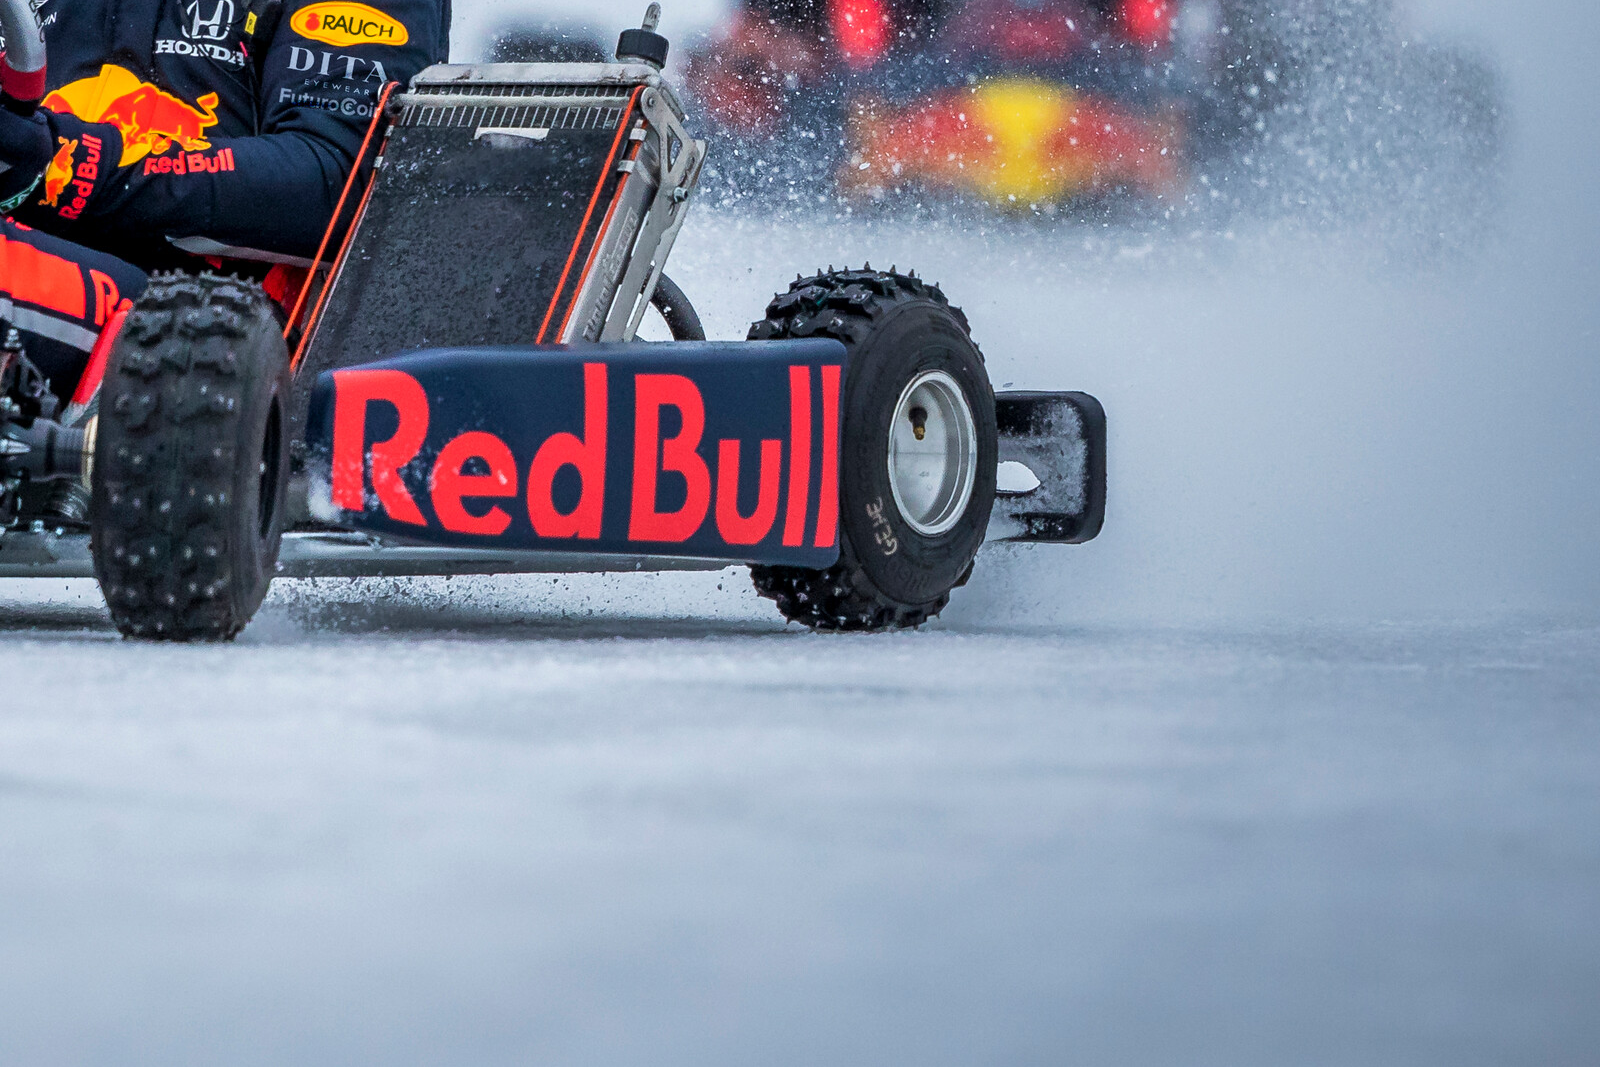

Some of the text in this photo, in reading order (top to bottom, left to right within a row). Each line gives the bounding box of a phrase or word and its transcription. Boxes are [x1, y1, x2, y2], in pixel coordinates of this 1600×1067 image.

[322, 15, 394, 38] RAUCH
[155, 39, 245, 67] HONDA
[286, 45, 388, 84] DITA
[304, 78, 370, 96] EYEWEAR
[143, 147, 235, 176] Red Bull
[58, 133, 102, 220] Red Bull
[331, 362, 841, 548] Red Bull
